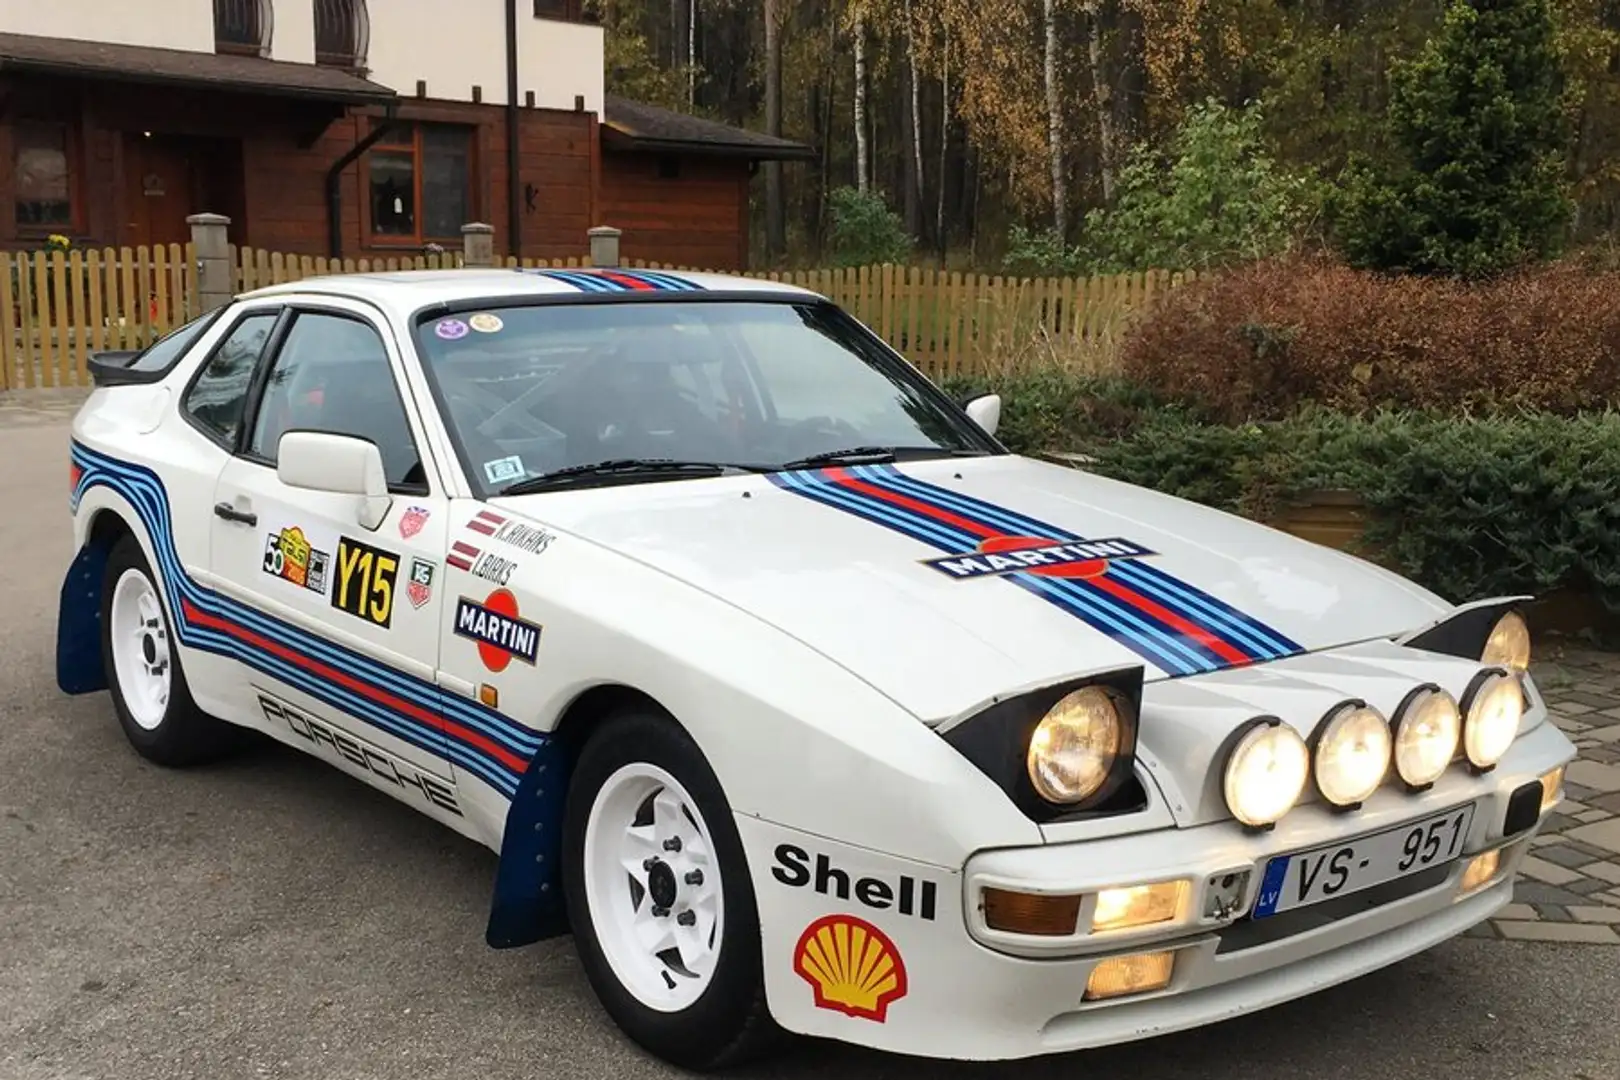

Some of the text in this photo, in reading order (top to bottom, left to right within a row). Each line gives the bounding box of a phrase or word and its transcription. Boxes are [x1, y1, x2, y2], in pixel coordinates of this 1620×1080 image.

[338, 542, 398, 623] Y15
[938, 540, 1140, 576] MARTINI
[458, 604, 536, 656] MARTINI
[257, 694, 465, 818] PORSCHE
[1398, 812, 1465, 871] 951
[771, 843, 937, 921] Shell
[1259, 890, 1278, 907] LV
